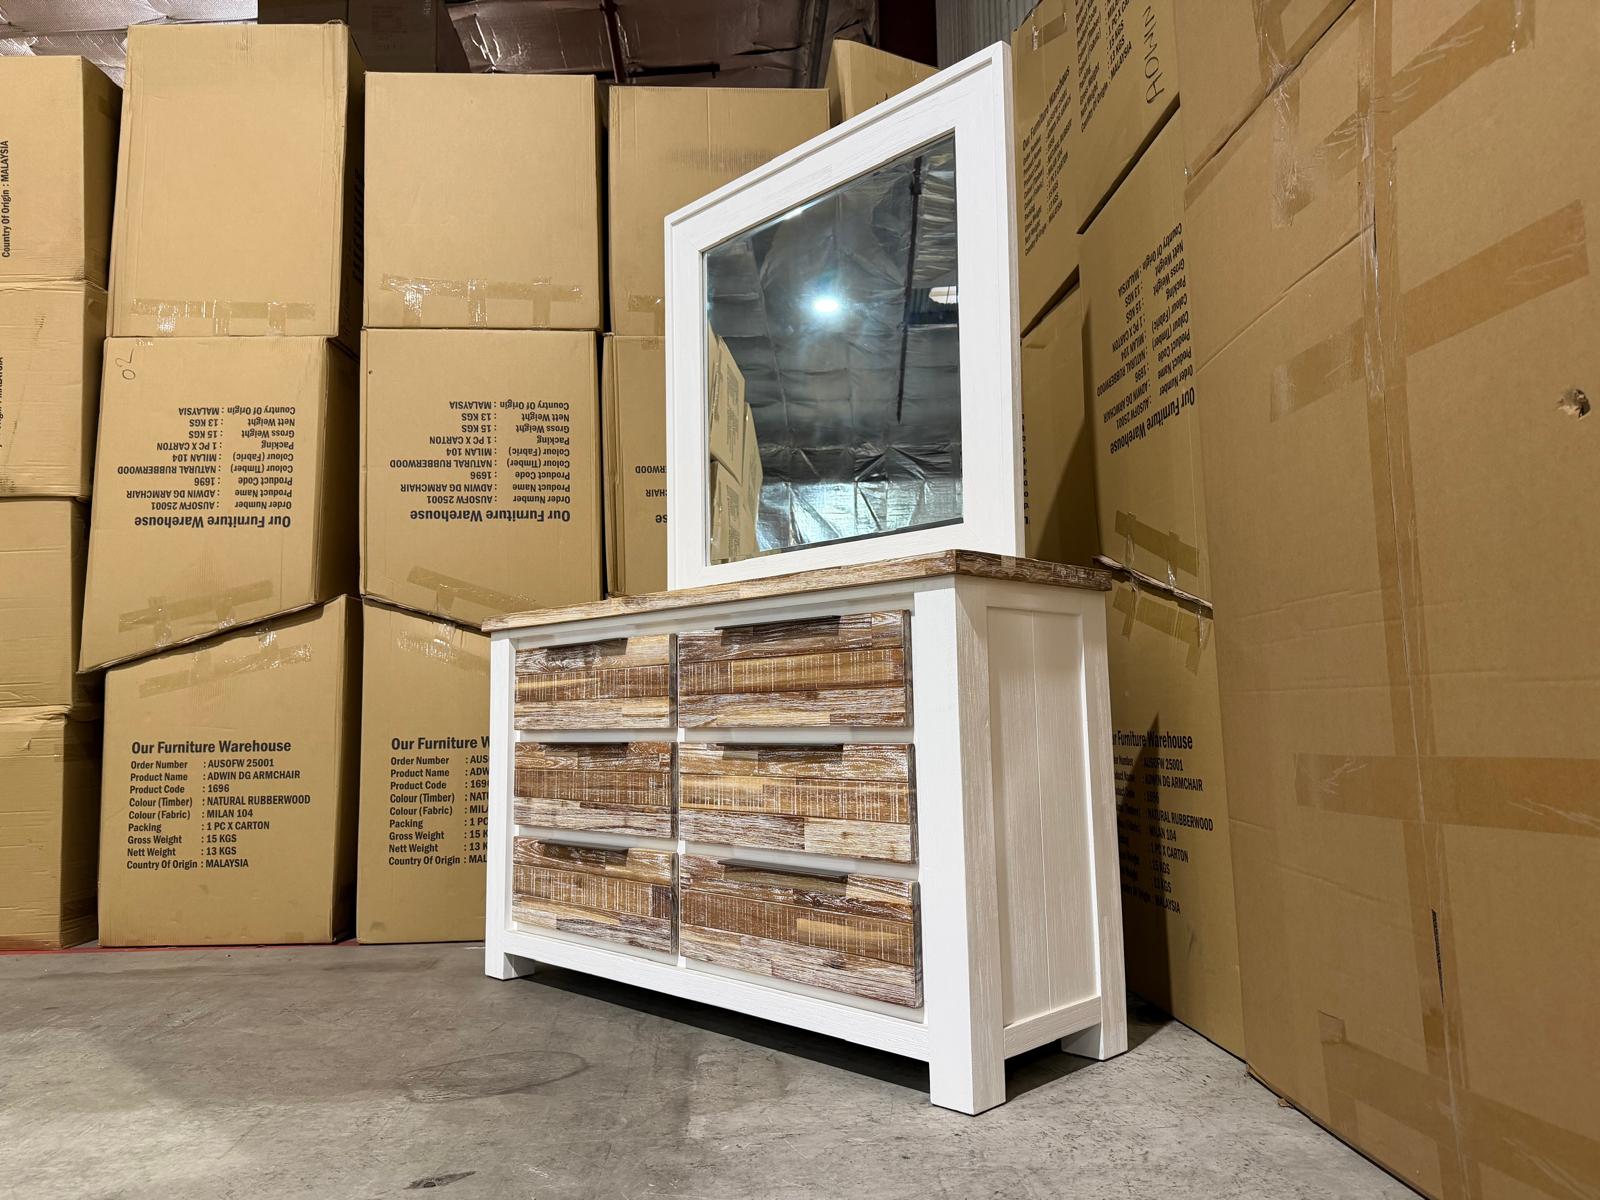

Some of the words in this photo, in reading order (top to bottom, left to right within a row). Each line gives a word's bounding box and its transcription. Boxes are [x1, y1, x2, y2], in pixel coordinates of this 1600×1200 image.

[1111, 39, 1131, 82] MALAYSIA
[0, 140, 9, 182] MALAYSIA
[1, 190, 12, 213] Origin
[2, 214, 10, 224] Of
[2, 226, 12, 258] Country
[1163, 224, 1183, 251] Country
[1157, 244, 1163, 259] Of
[1143, 250, 1157, 271] Origin
[1118, 268, 1140, 299] MALAYSIA
[1181, 387, 1196, 409] Our
[449, 401, 492, 409] MALAYSIA
[500, 399, 524, 410] Origin
[537, 400, 569, 410] Country
[178, 407, 220, 416] MALAYSIA
[227, 405, 252, 416] Origin
[253, 407, 263, 415] Of
[264, 405, 296, 415] Country
[1147, 397, 1180, 431] Furniture
[190, 419, 206, 427] KGS
[208, 419, 219, 427] 13
[248, 417, 276, 427] Weight
[278, 418, 296, 427] Nett
[189, 431, 206, 439] KGS
[208, 431, 218, 439] 15
[242, 429, 270, 439] Weight
[1111, 422, 1146, 456] Warehouse
[157, 443, 190, 451] CARTON
[192, 442, 198, 451] X
[199, 442, 211, 450] PC
[213, 442, 218, 450] 1
[262, 441, 295, 451] Packing
[446, 448, 462, 456] 104
[465, 448, 492, 456] MILAN
[508, 447, 541, 457] (Fabric)
[543, 448, 570, 456] Colour
[173, 455, 188, 463] 104
[190, 454, 218, 463] MILAN
[233, 452, 266, 462] (Fabric)
[267, 454, 294, 462] Colour
[390, 460, 452, 468] RUBBERWOOD
[453, 460, 492, 468] NATURAL
[507, 459, 541, 468] (Timber)
[543, 460, 570, 468] Colour
[118, 466, 178, 475] RUBBERWOOD
[179, 466, 217, 474] NATURAL
[231, 464, 265, 474] (Timber)
[267, 465, 294, 474] Colour
[470, 472, 492, 480] 1696
[515, 472, 536, 480] Code
[538, 472, 570, 480] Product
[195, 478, 216, 486] 1696
[238, 477, 259, 486] Code
[261, 477, 293, 485] Product
[400, 484, 448, 492] ARMCHAIR
[450, 484, 462, 492] DG
[464, 484, 492, 492] ADWIN
[513, 484, 536, 492] Name
[538, 484, 570, 492] Product
[127, 490, 172, 499] ARMCHAIR
[174, 490, 186, 499] DG
[188, 490, 216, 498] ADWIN
[235, 490, 259, 498] Name
[261, 490, 293, 498] Product
[427, 496, 454, 504] 25001
[456, 496, 492, 504] AUSOFW
[513, 496, 546, 504] Number
[547, 496, 570, 504] Order
[152, 502, 178, 511] 25001
[180, 502, 215, 510] AUSOFW
[235, 502, 268, 510] Number
[269, 502, 292, 510] Order
[410, 510, 483, 522] Warehouse
[486, 510, 544, 522] Furniture
[548, 510, 570, 522] Our
[134, 517, 204, 528] Warehouse
[208, 516, 266, 528] Furniture
[268, 516, 291, 528] Our
[391, 738, 415, 750] Our
[418, 737, 477, 750] Furniture
[1147, 731, 1192, 749] Warehouse
[131, 742, 154, 754] Our
[157, 741, 215, 754] Furniture
[219, 740, 291, 752] Warehouse
[131, 761, 154, 769] Order
[155, 760, 188, 769] Number
[208, 759, 244, 768] AUSOFW
[246, 758, 274, 767] 25001
[391, 757, 414, 766] Order
[416, 756, 449, 765] Number
[470, 754, 489, 763] AUS
[1165, 758, 1183, 771] 25001
[130, 773, 162, 782] Product
[164, 773, 188, 781] Name
[208, 771, 237, 780] ADWIN
[239, 771, 251, 780] DG
[253, 770, 300, 779] ARMCHAIR
[390, 769, 423, 778] Product
[425, 768, 449, 777] Name
[470, 767, 489, 776] ADW
[390, 782, 423, 791] Product
[425, 781, 446, 790] Code
[470, 780, 489, 789] 169
[1162, 775, 1170, 787] DG
[1171, 776, 1202, 792] ARMCHAIR
[130, 786, 162, 795] Product
[164, 785, 185, 794] Code
[208, 784, 230, 793] 1696
[129, 798, 156, 807] Colour
[158, 797, 193, 808] (Timber)
[207, 796, 246, 806] NATURAL
[248, 795, 310, 805] RUBBERWOOD
[390, 794, 418, 804] Colour
[419, 793, 455, 804] (Timber)
[129, 811, 156, 819] Colour
[158, 810, 190, 820] (Fabric)
[207, 809, 235, 818] MILAN
[237, 808, 253, 817] 104
[1171, 812, 1213, 832] RUBBERWOOD
[128, 822, 162, 833] Packing
[207, 822, 211, 831] 1
[214, 822, 226, 831] PC
[227, 822, 233, 830] X
[235, 821, 270, 830] CARTON
[128, 836, 151, 844] Gross
[153, 835, 182, 845] Weight
[207, 835, 217, 843] 15
[219, 834, 237, 843] KGS
[127, 848, 145, 856] Nett
[147, 847, 176, 858] Weight
[206, 847, 217, 856] 13
[219, 847, 237, 856] KGS
[1167, 846, 1189, 864] CARTON
[127, 860, 159, 871] Country
[161, 860, 171, 869] Of
[172, 860, 197, 871] Origin
[205, 859, 248, 868] MALAYSIA
[388, 856, 422, 867] Country
[423, 856, 433, 865] Of
[435, 855, 460, 867] Origin
